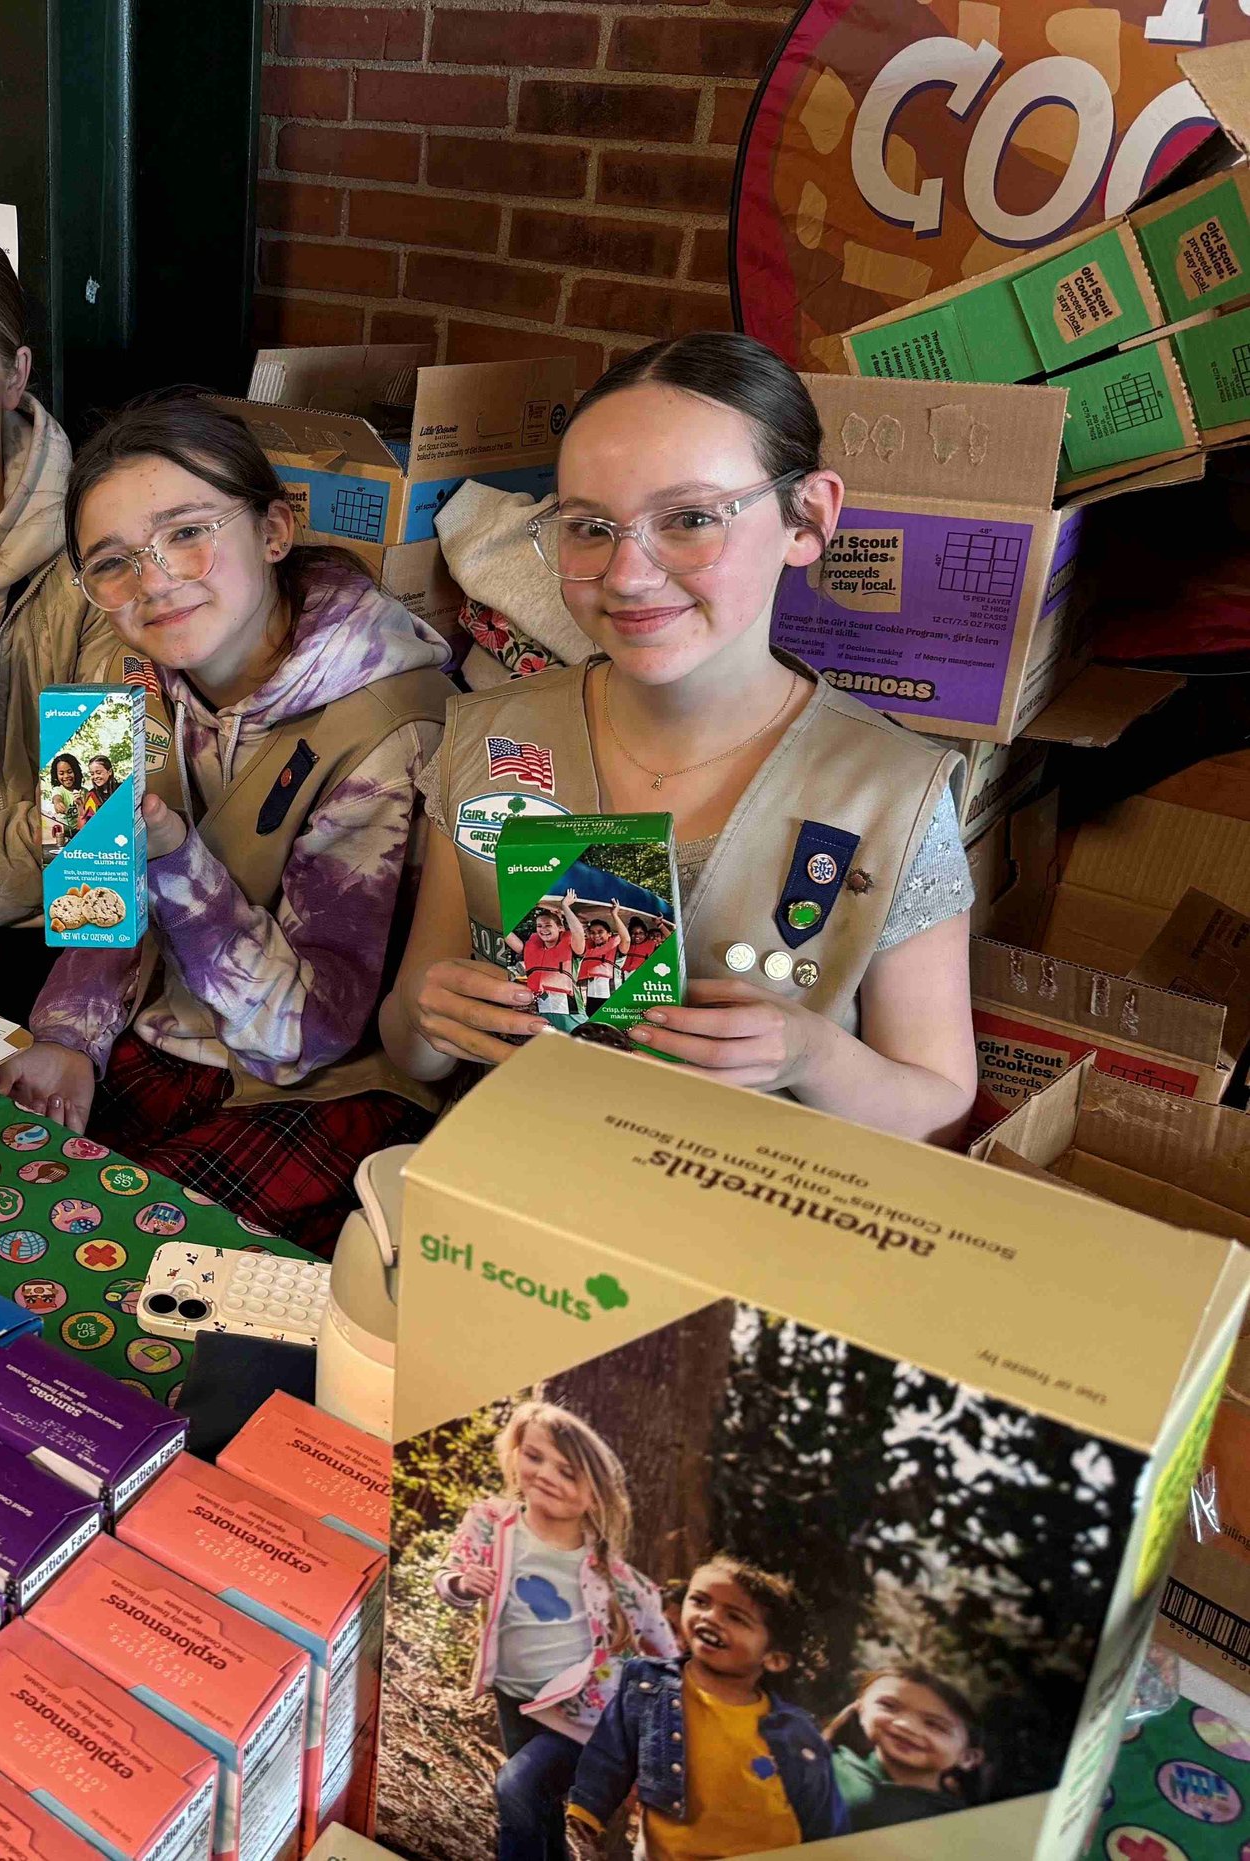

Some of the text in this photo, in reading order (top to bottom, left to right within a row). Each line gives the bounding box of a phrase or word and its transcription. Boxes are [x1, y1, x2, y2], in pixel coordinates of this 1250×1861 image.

[1187, 237, 1212, 276] proceeds
[1206, 221, 1238, 276] Girl Scout
[1183, 250, 1210, 293] stay local.
[1060, 282, 1086, 320] proceeds
[1082, 266, 1113, 318] Girl Scout
[1058, 295, 1086, 336] stay local.
[930, 330, 944, 358] Through
[904, 348, 918, 376] Decision
[416, 452, 430, 461] baked
[848, 536, 898, 550] Scout
[832, 578, 896, 592] stay local.
[780, 612, 999, 646] Through Girl Scout Cookie girls learn
[846, 643, 876, 654] Decision
[923, 654, 995, 669] Money management
[822, 670, 932, 698] samoas
[45, 708, 80, 720] girl scouts
[152, 732, 168, 744] USA
[463, 810, 488, 822] GIRL
[470, 829, 499, 842] GREEN
[508, 864, 553, 874] girl scouts
[643, 980, 672, 992] thin
[977, 1040, 1064, 1068] Girl Scout
[981, 1068, 1043, 1088] proceeds
[991, 1082, 1022, 1100] stay
[756, 1144, 870, 1188] open here
[604, 1114, 1018, 1260] Scout only from Girl Scouts
[420, 1232, 593, 1322] girl scouts
[1001, 1360, 1107, 1406] Use freeze
[28, 1384, 82, 1418] samoas
[116, 1434, 184, 1502] Nutrition Facts
[292, 1439, 390, 1496] ploremores
[187, 1504, 312, 1574] exploremores
[23, 1519, 98, 1595] Nutrition Facts
[103, 1592, 229, 1672] exploremores
[243, 1703, 285, 1758] Nutrition
[282, 1668, 308, 1706] Facts
[16, 1688, 136, 1782] exploremores
[187, 1776, 215, 1816] Facts
